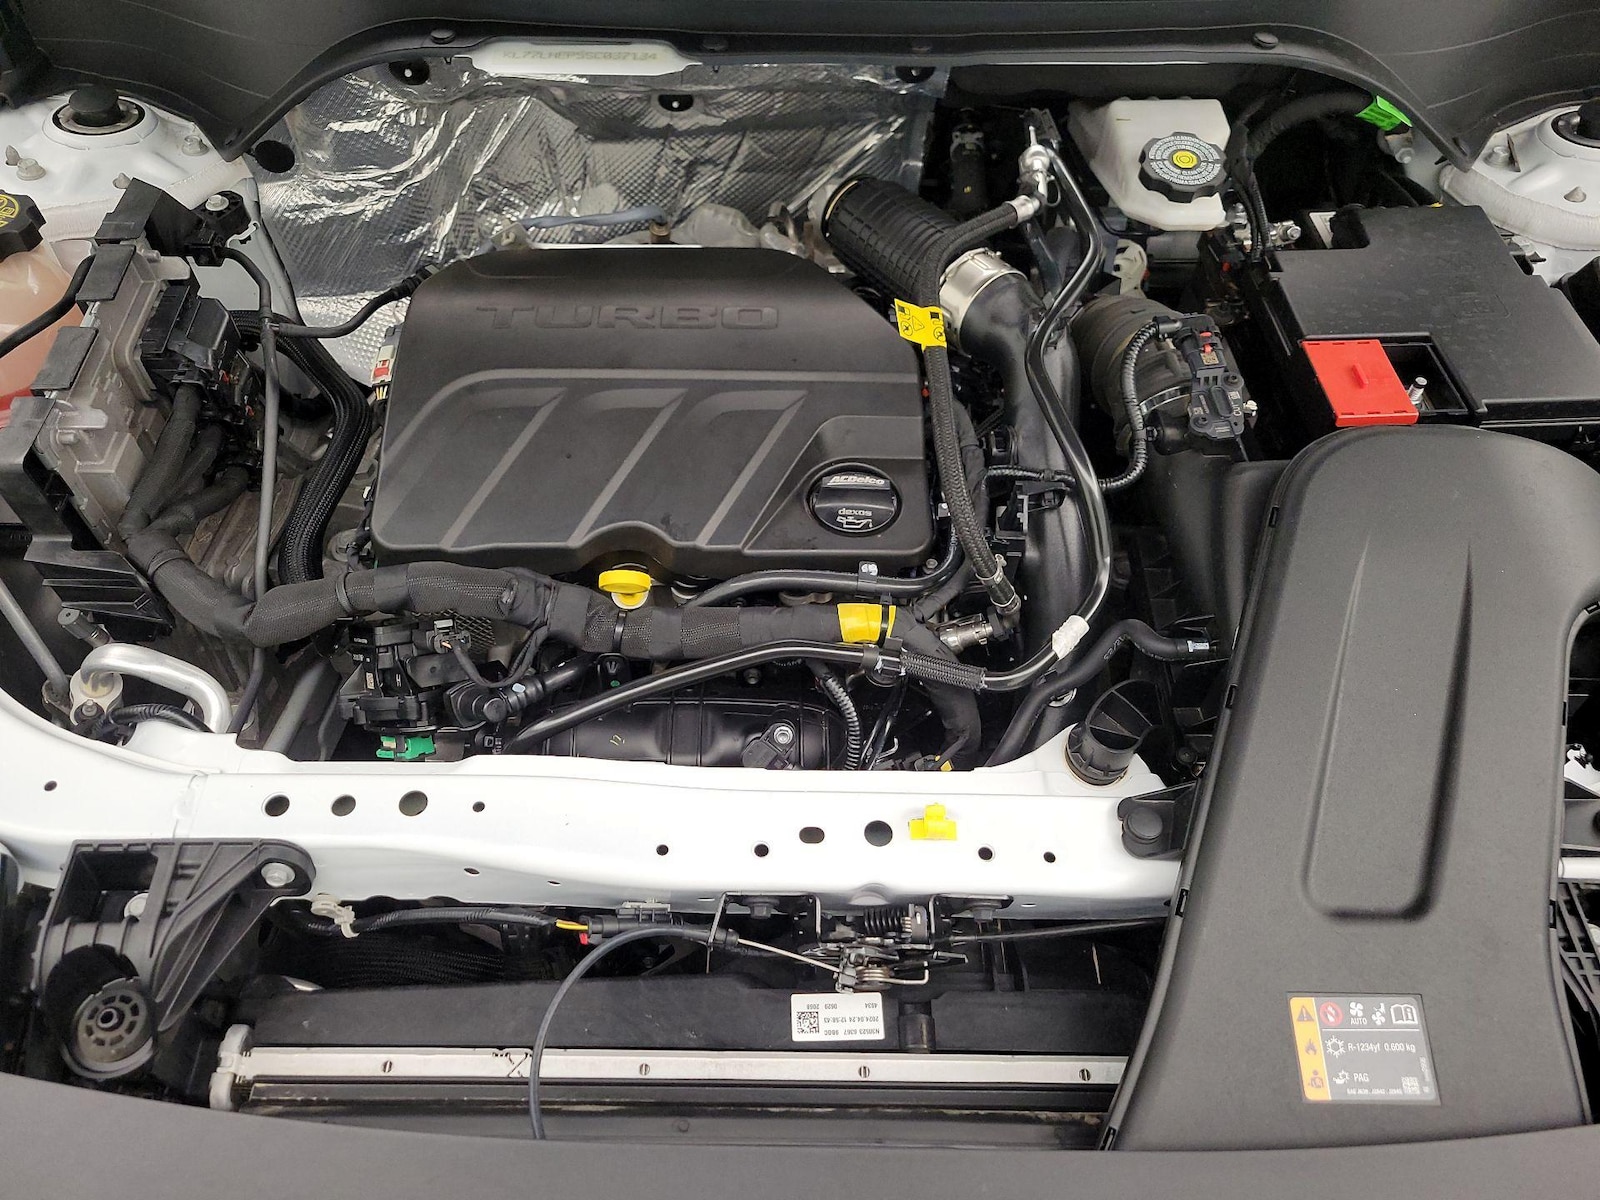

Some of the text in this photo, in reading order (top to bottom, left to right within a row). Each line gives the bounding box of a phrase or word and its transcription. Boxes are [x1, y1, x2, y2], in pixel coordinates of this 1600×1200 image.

[475, 306, 779, 329] TURBO
[827, 475, 885, 486] ACDelco
[837, 507, 873, 517] dexos
[1350, 1017, 1368, 1025] AUTO
[1347, 1042, 1416, 1054] R-1234yf 0.600 kg
[1353, 1072, 1369, 1083] PAG
